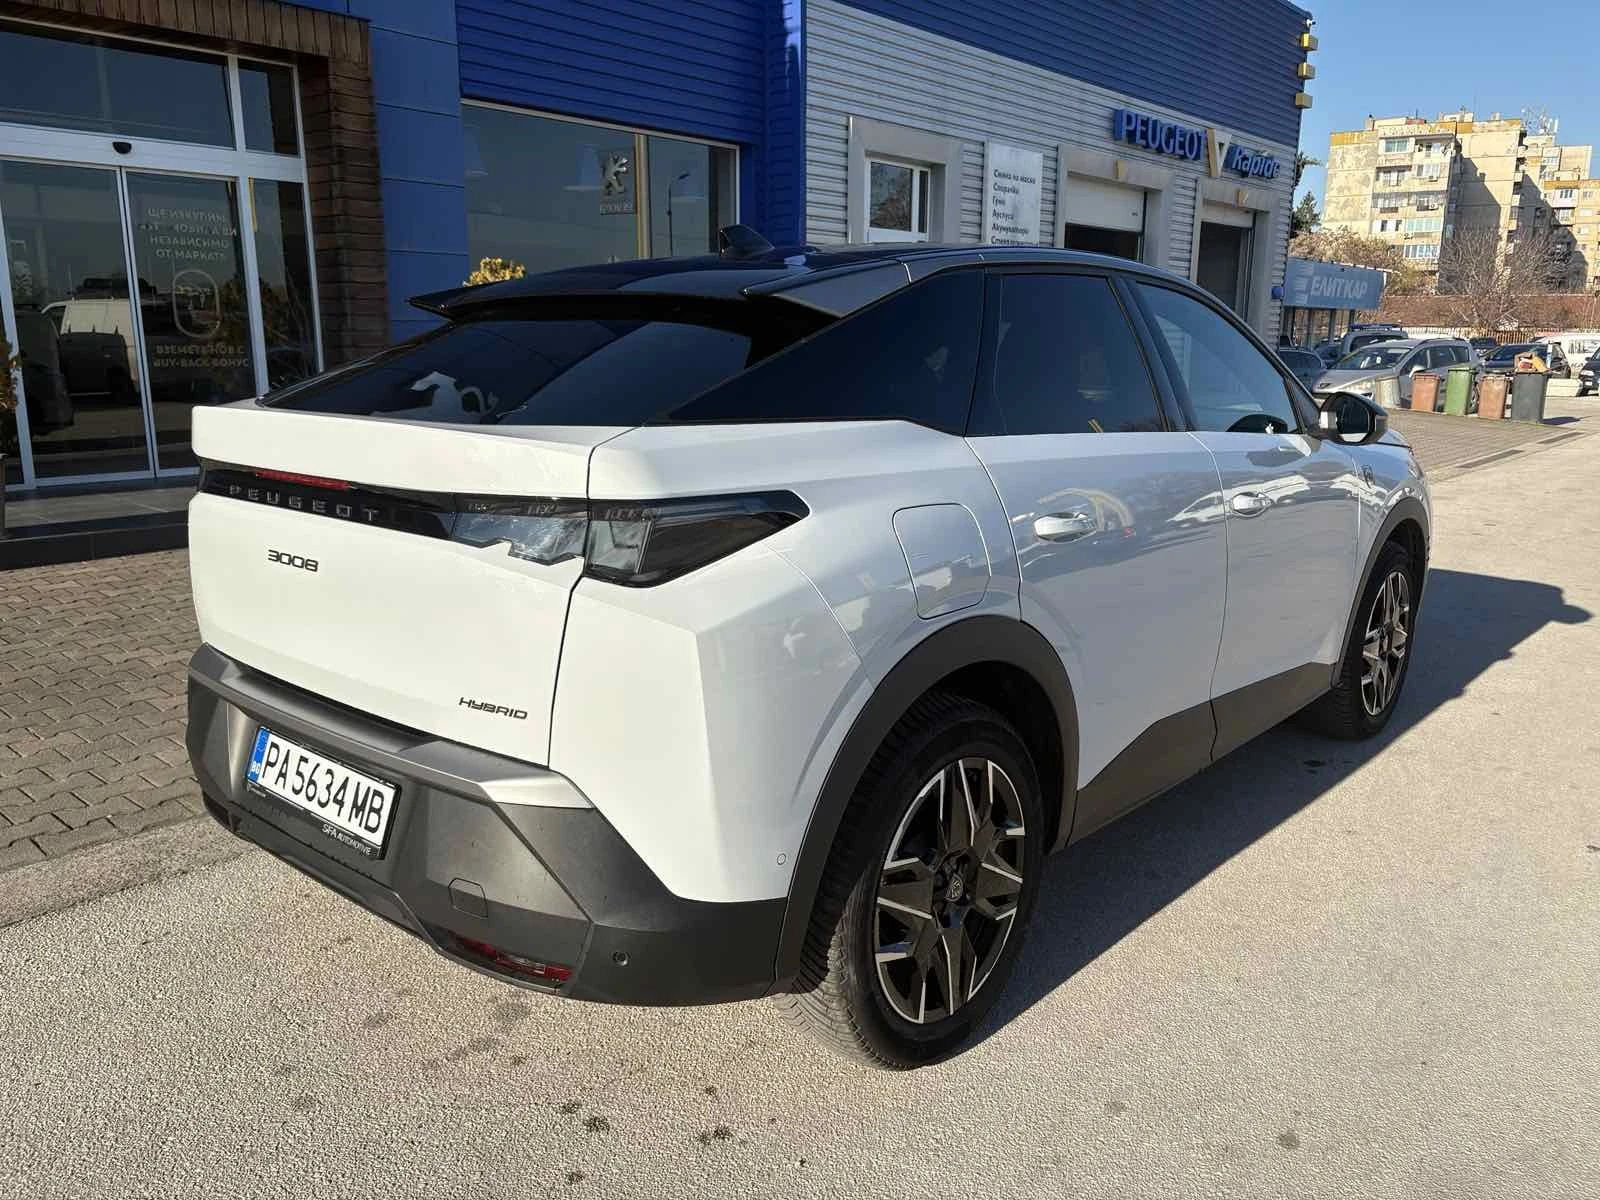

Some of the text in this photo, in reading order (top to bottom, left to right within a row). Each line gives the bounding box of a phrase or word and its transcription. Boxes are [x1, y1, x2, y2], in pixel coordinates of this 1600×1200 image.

[1114, 108, 1207, 162] PEUGEOT
[229, 484, 380, 521] PEUGEOT
[267, 549, 319, 573] 3008
[458, 696, 529, 720] HYBRID
[321, 823, 372, 856] SFA AUTOMOTIVE
